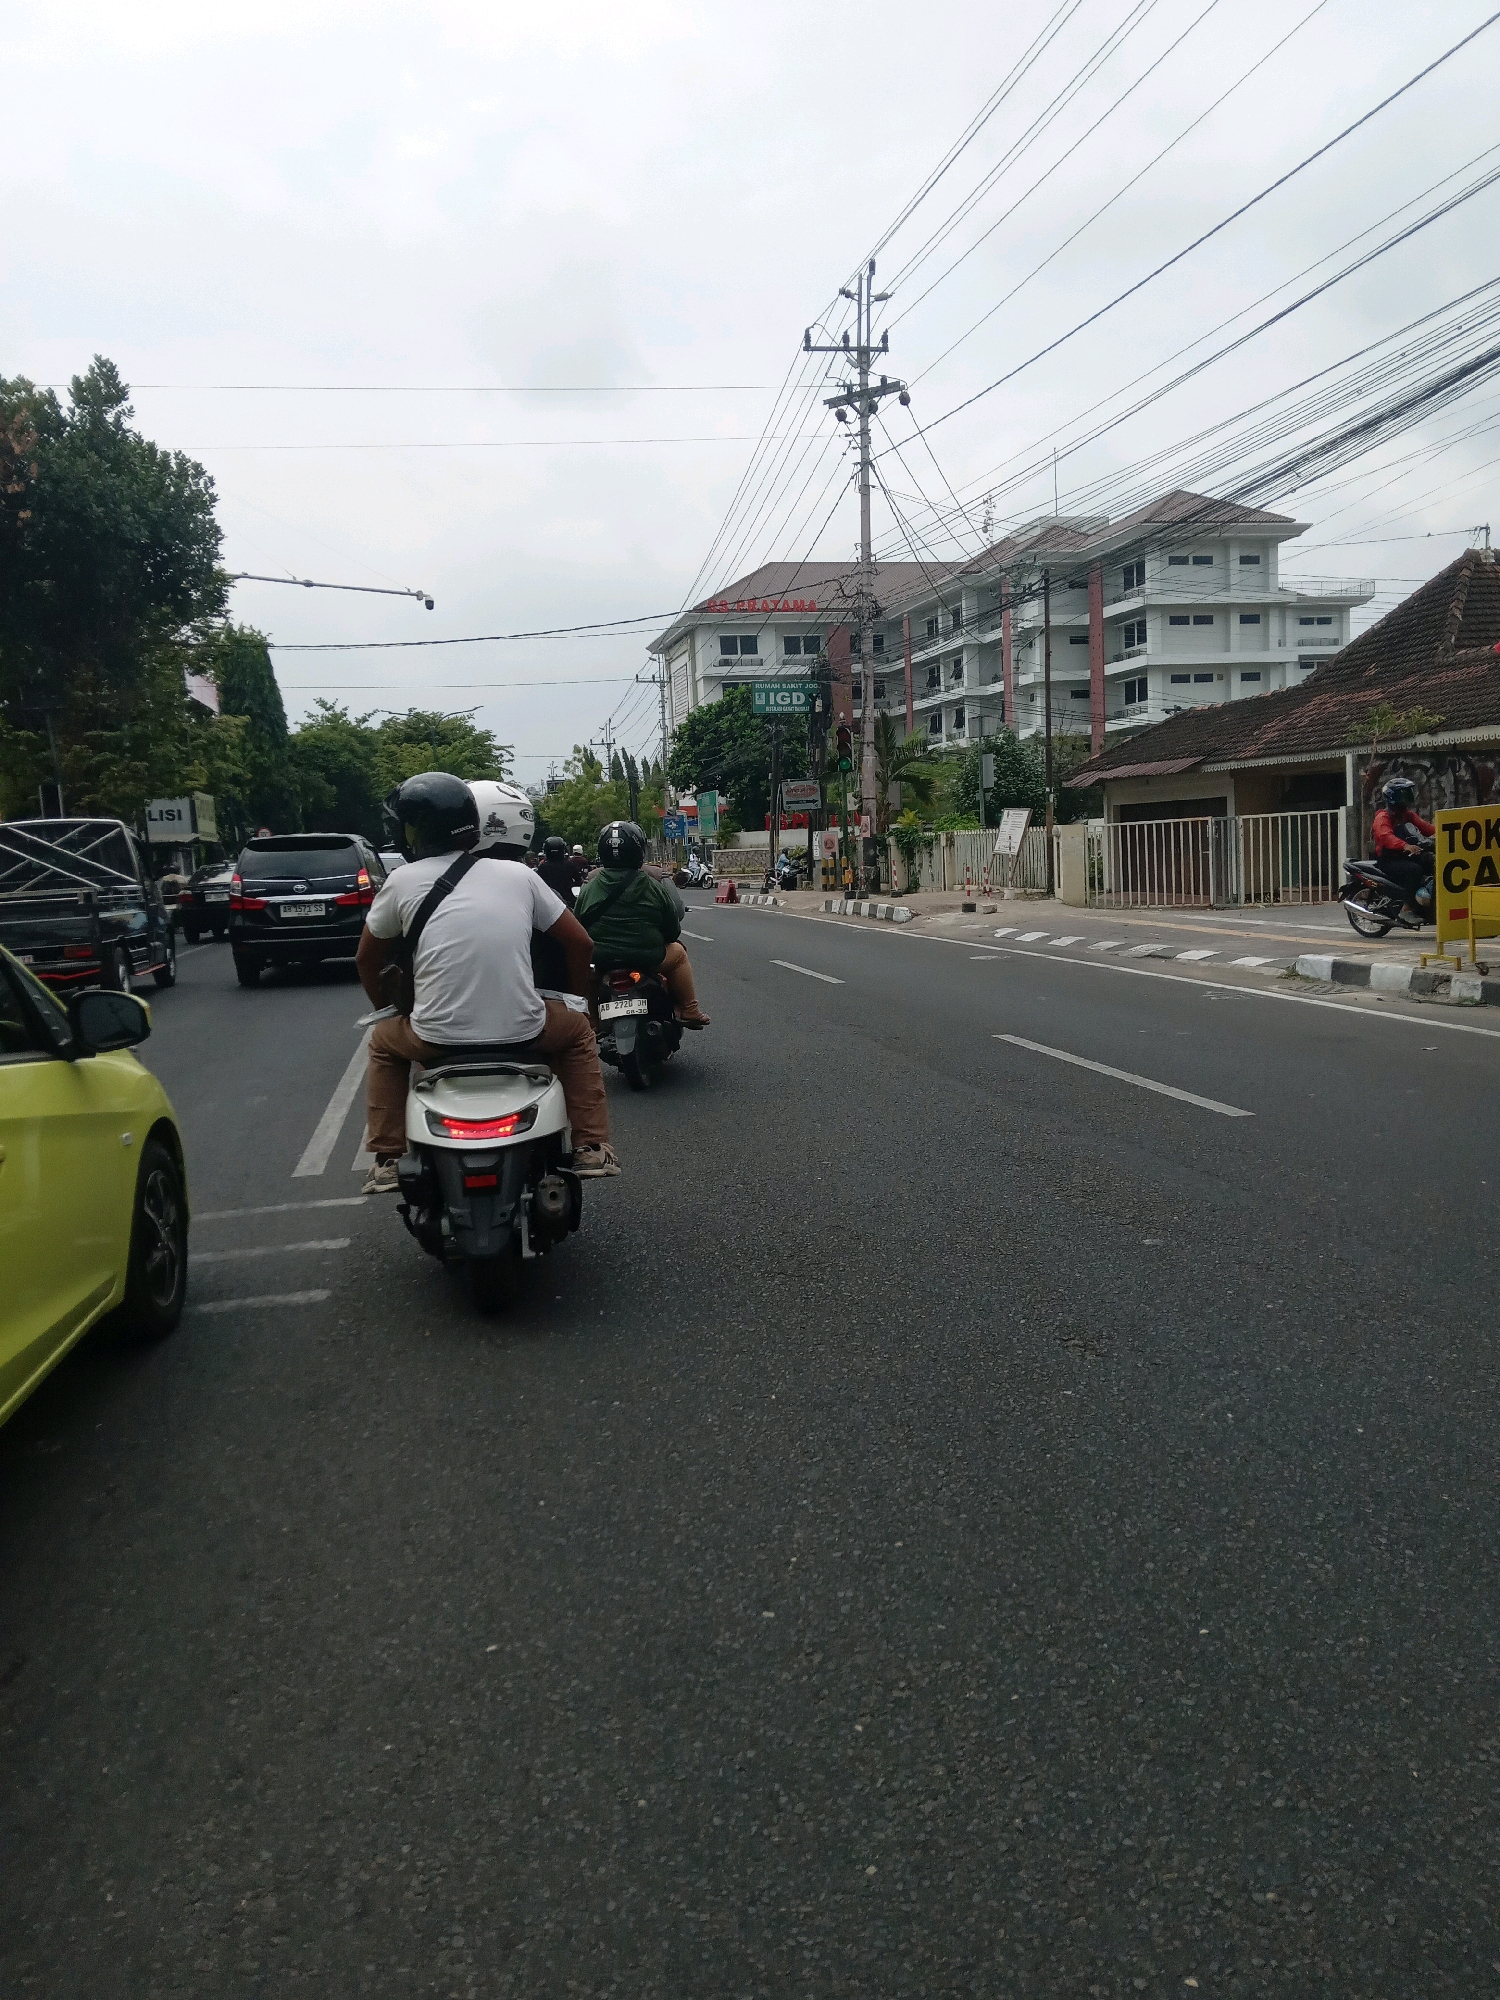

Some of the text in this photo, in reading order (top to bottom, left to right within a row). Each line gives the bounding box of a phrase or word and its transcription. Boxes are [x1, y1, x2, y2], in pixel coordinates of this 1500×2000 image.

[707, 599, 818, 612] RS PRATAMA
[769, 691, 806, 705] IGD
[149, 809, 182, 821] LISI
[450, 824, 475, 835] HONDA
[1441, 818, 1500, 853] TOK
[600, 1003, 611, 1012] AB
